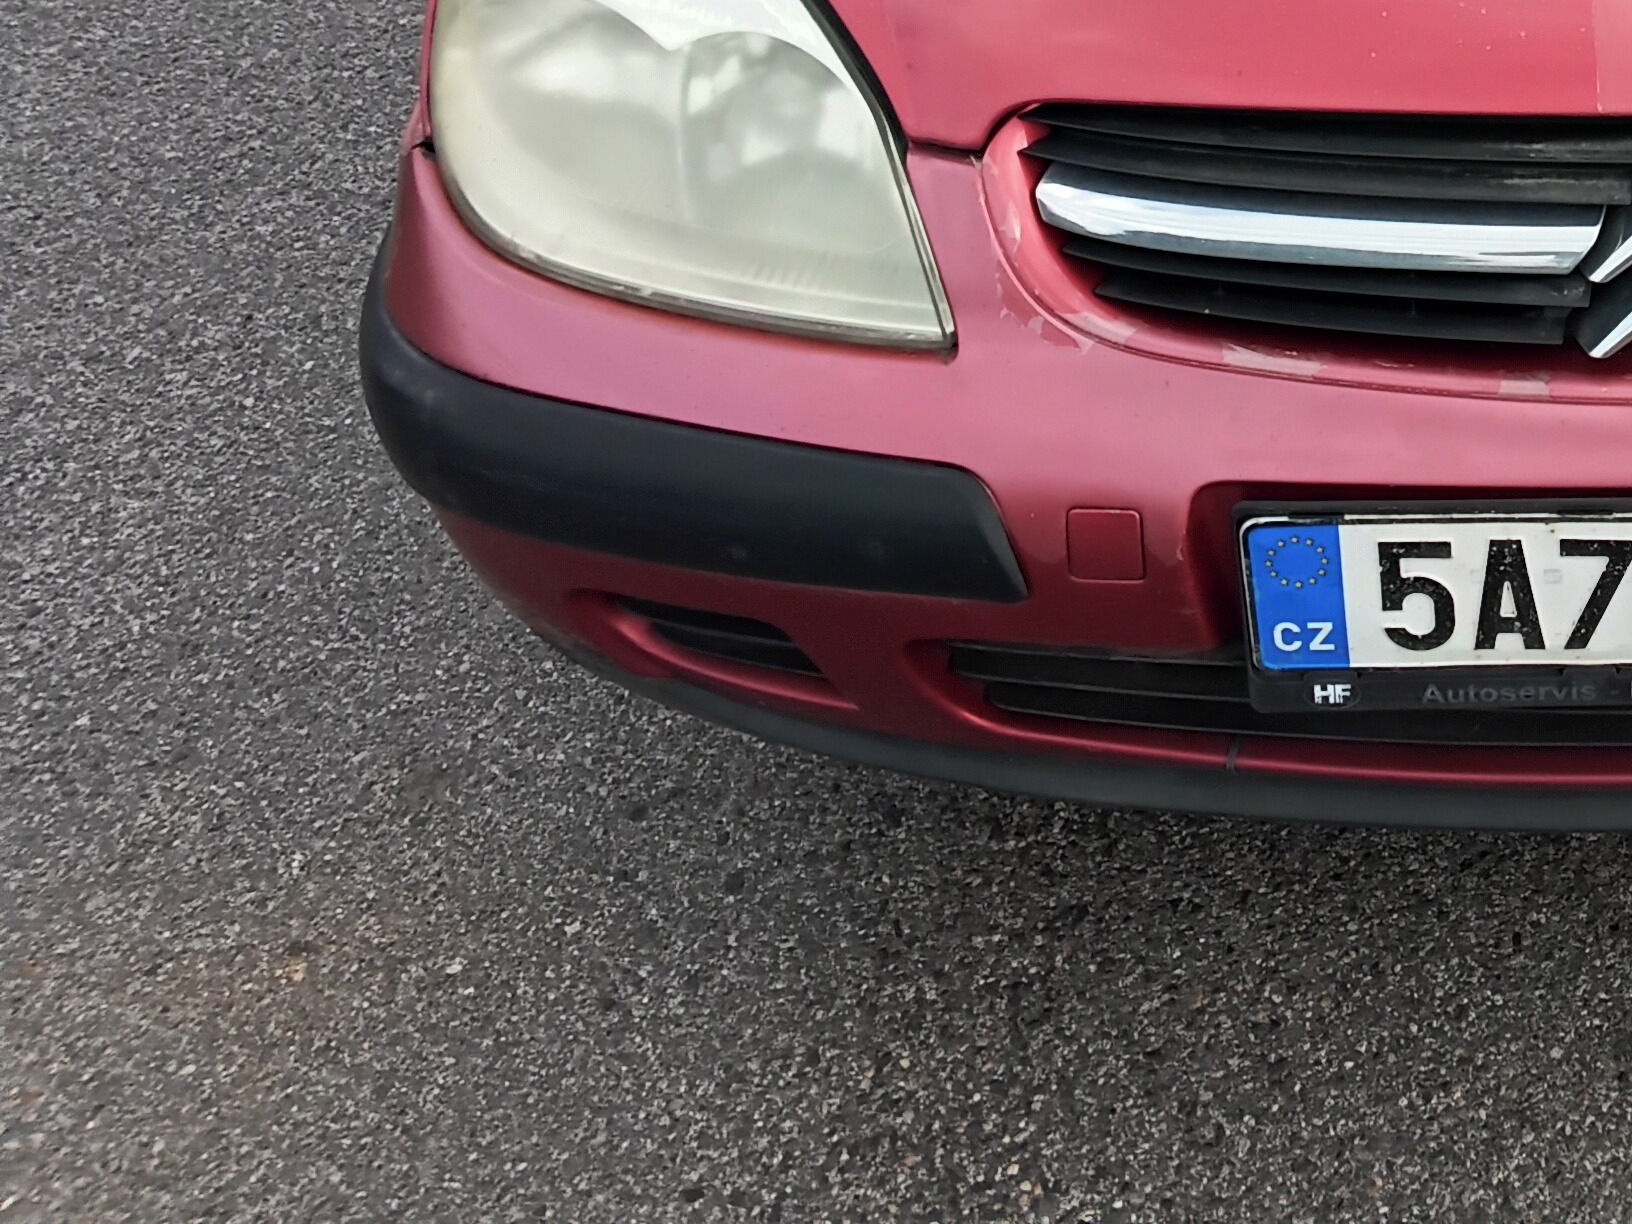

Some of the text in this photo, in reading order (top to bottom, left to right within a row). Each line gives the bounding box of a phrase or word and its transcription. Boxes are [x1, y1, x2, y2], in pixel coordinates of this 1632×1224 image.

[1272, 621, 1336, 652] CZ
[1313, 683, 1353, 705] HF
[1421, 682, 1597, 705] Autoservis
